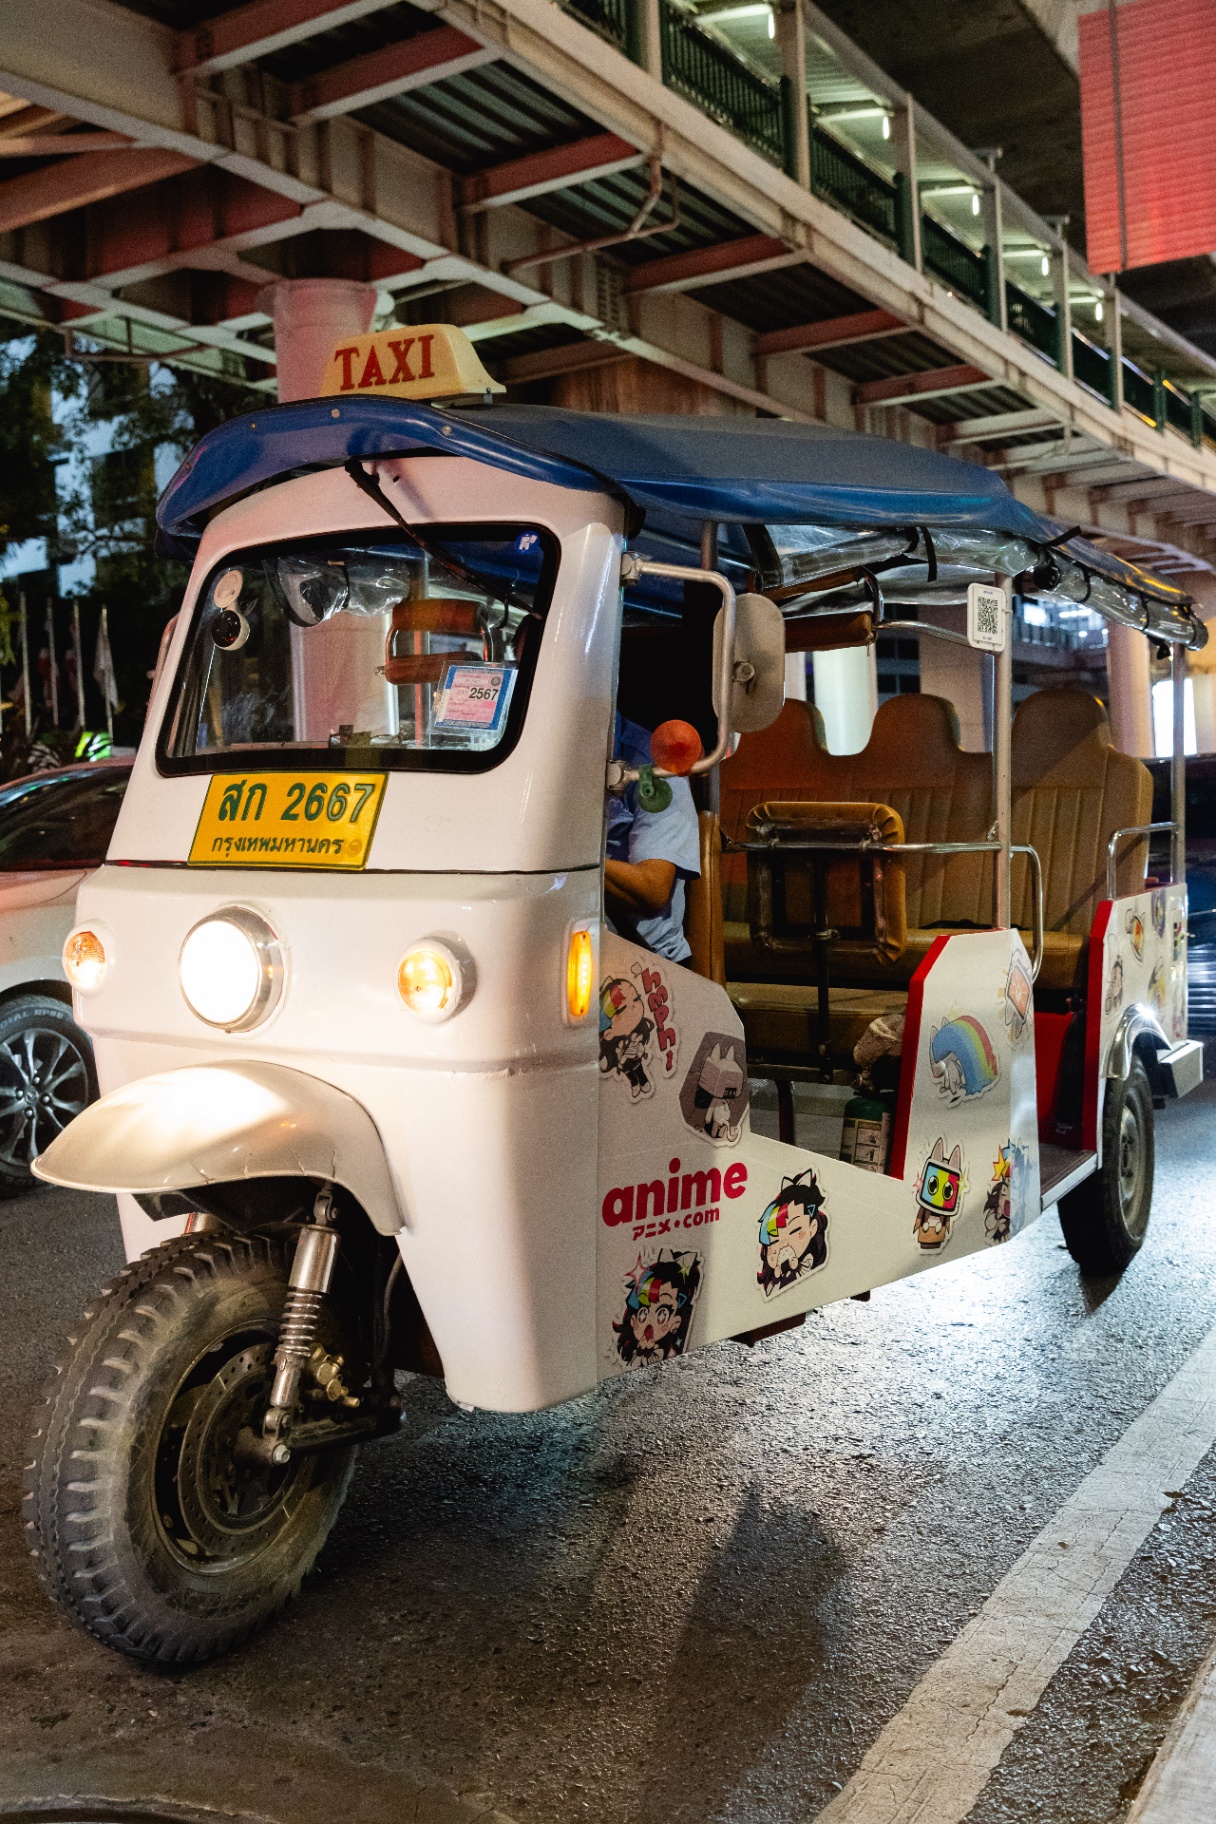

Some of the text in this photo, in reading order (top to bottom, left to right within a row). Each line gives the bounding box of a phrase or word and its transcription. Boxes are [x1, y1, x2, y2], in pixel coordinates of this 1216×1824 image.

[334, 334, 434, 391] TAXI
[469, 687, 499, 701] 2567
[218, 779, 376, 824] สก 2667
[211, 836, 344, 858] กรุงเทพมหานคร
[602, 1157, 748, 1227] anime
